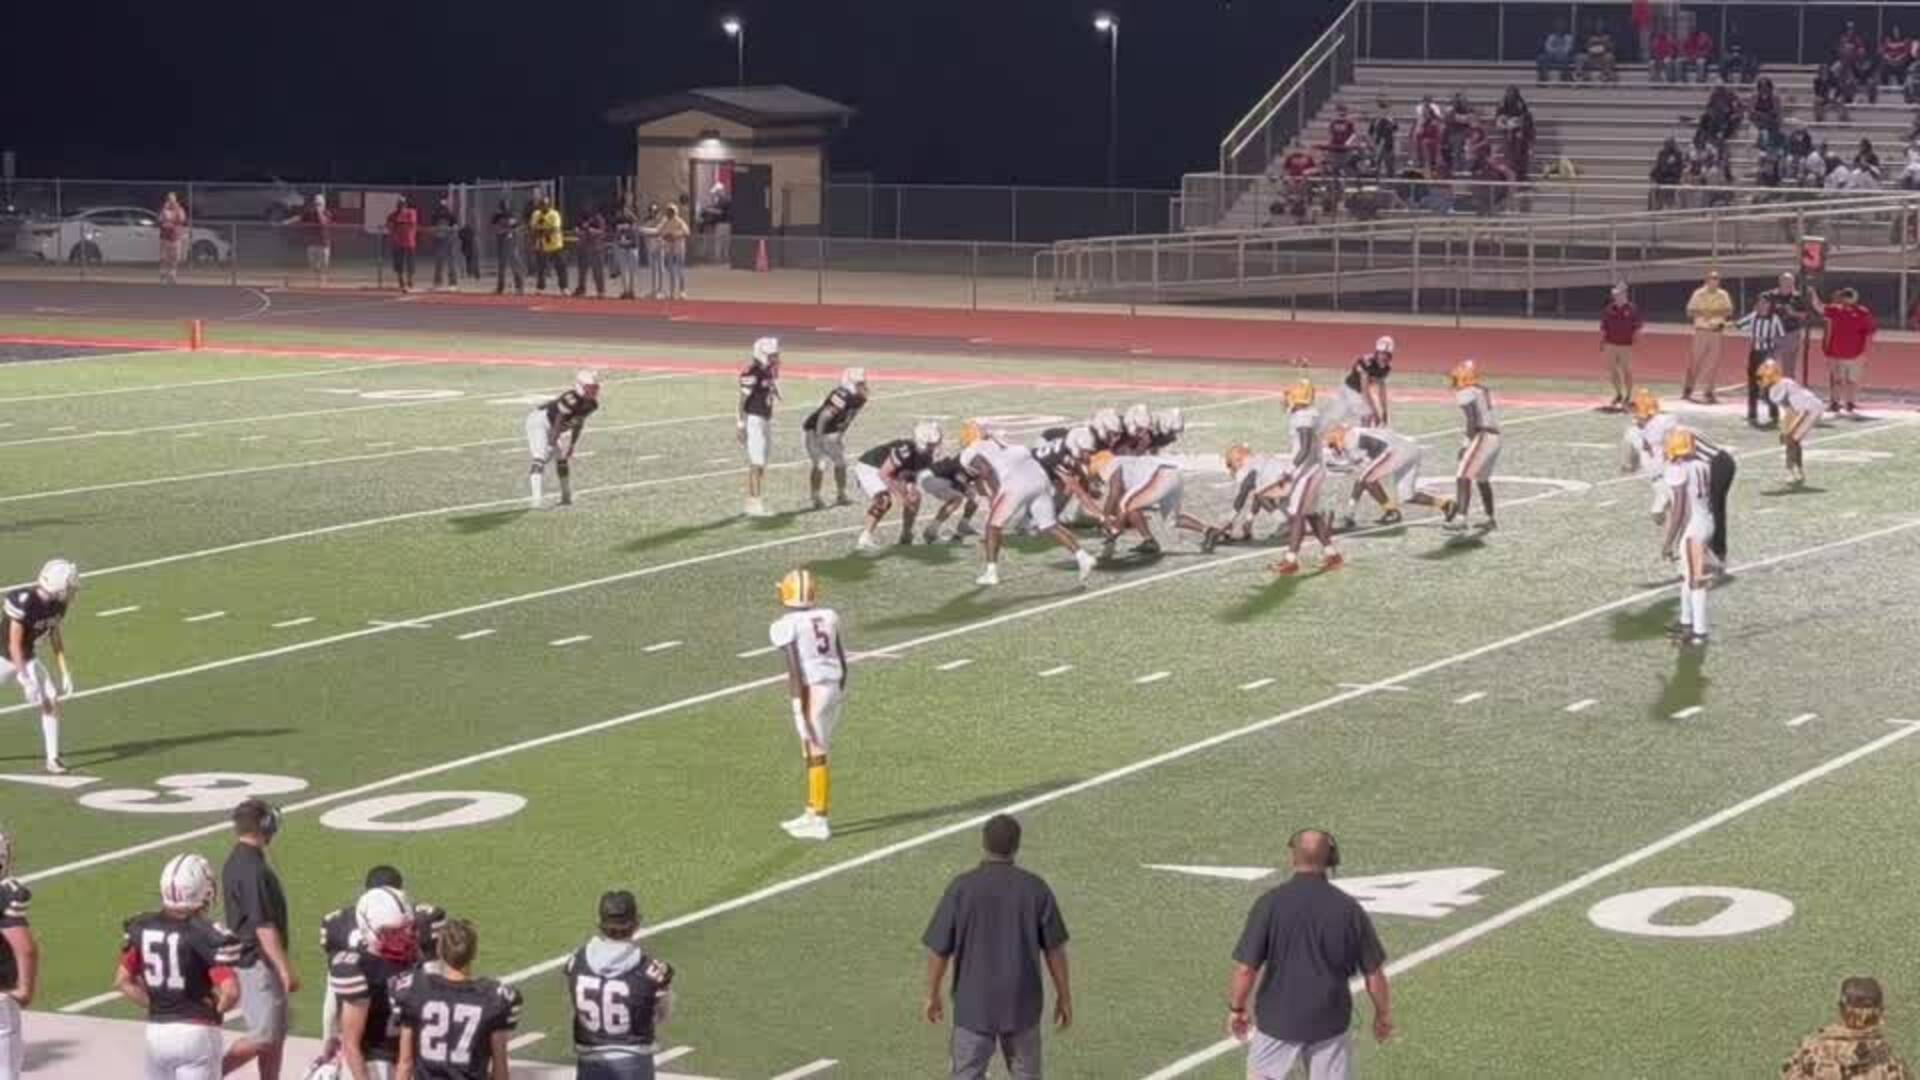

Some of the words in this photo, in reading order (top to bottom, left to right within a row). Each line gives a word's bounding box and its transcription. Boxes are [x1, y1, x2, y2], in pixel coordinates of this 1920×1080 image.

[811, 616, 830, 654] 5
[141, 928, 185, 990] 51
[419, 1000, 483, 1064] 27
[575, 974, 631, 1035] 56
